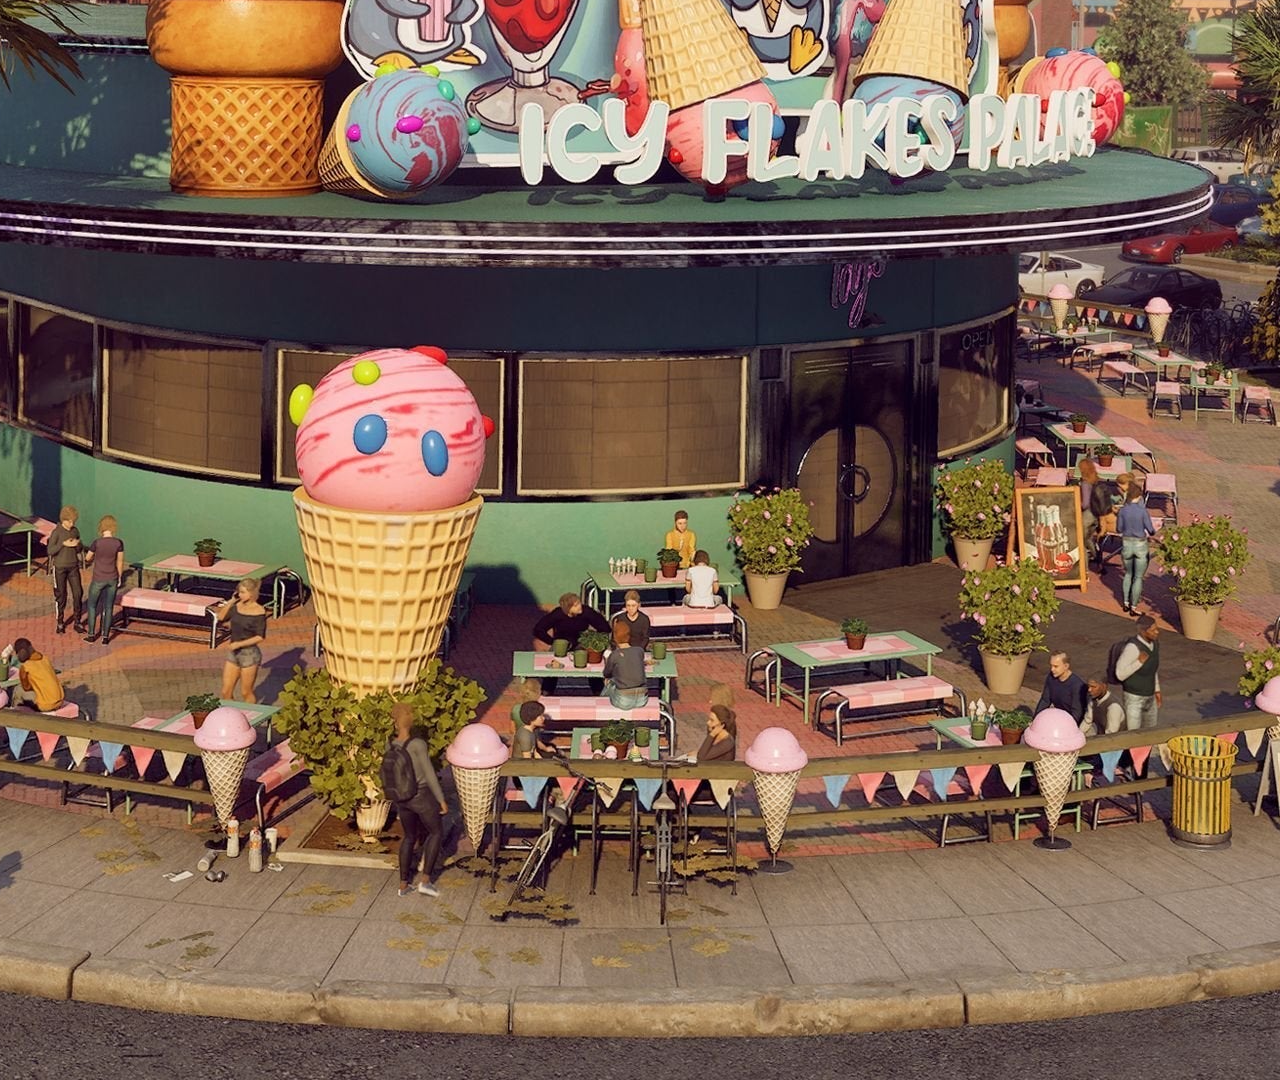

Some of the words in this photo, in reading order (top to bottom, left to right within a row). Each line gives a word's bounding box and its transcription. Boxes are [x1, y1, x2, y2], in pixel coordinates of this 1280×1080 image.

[519, 98, 670, 186] ICY
[702, 94, 958, 185] FLAKES
[967, 86, 1096, 171] PALACE
